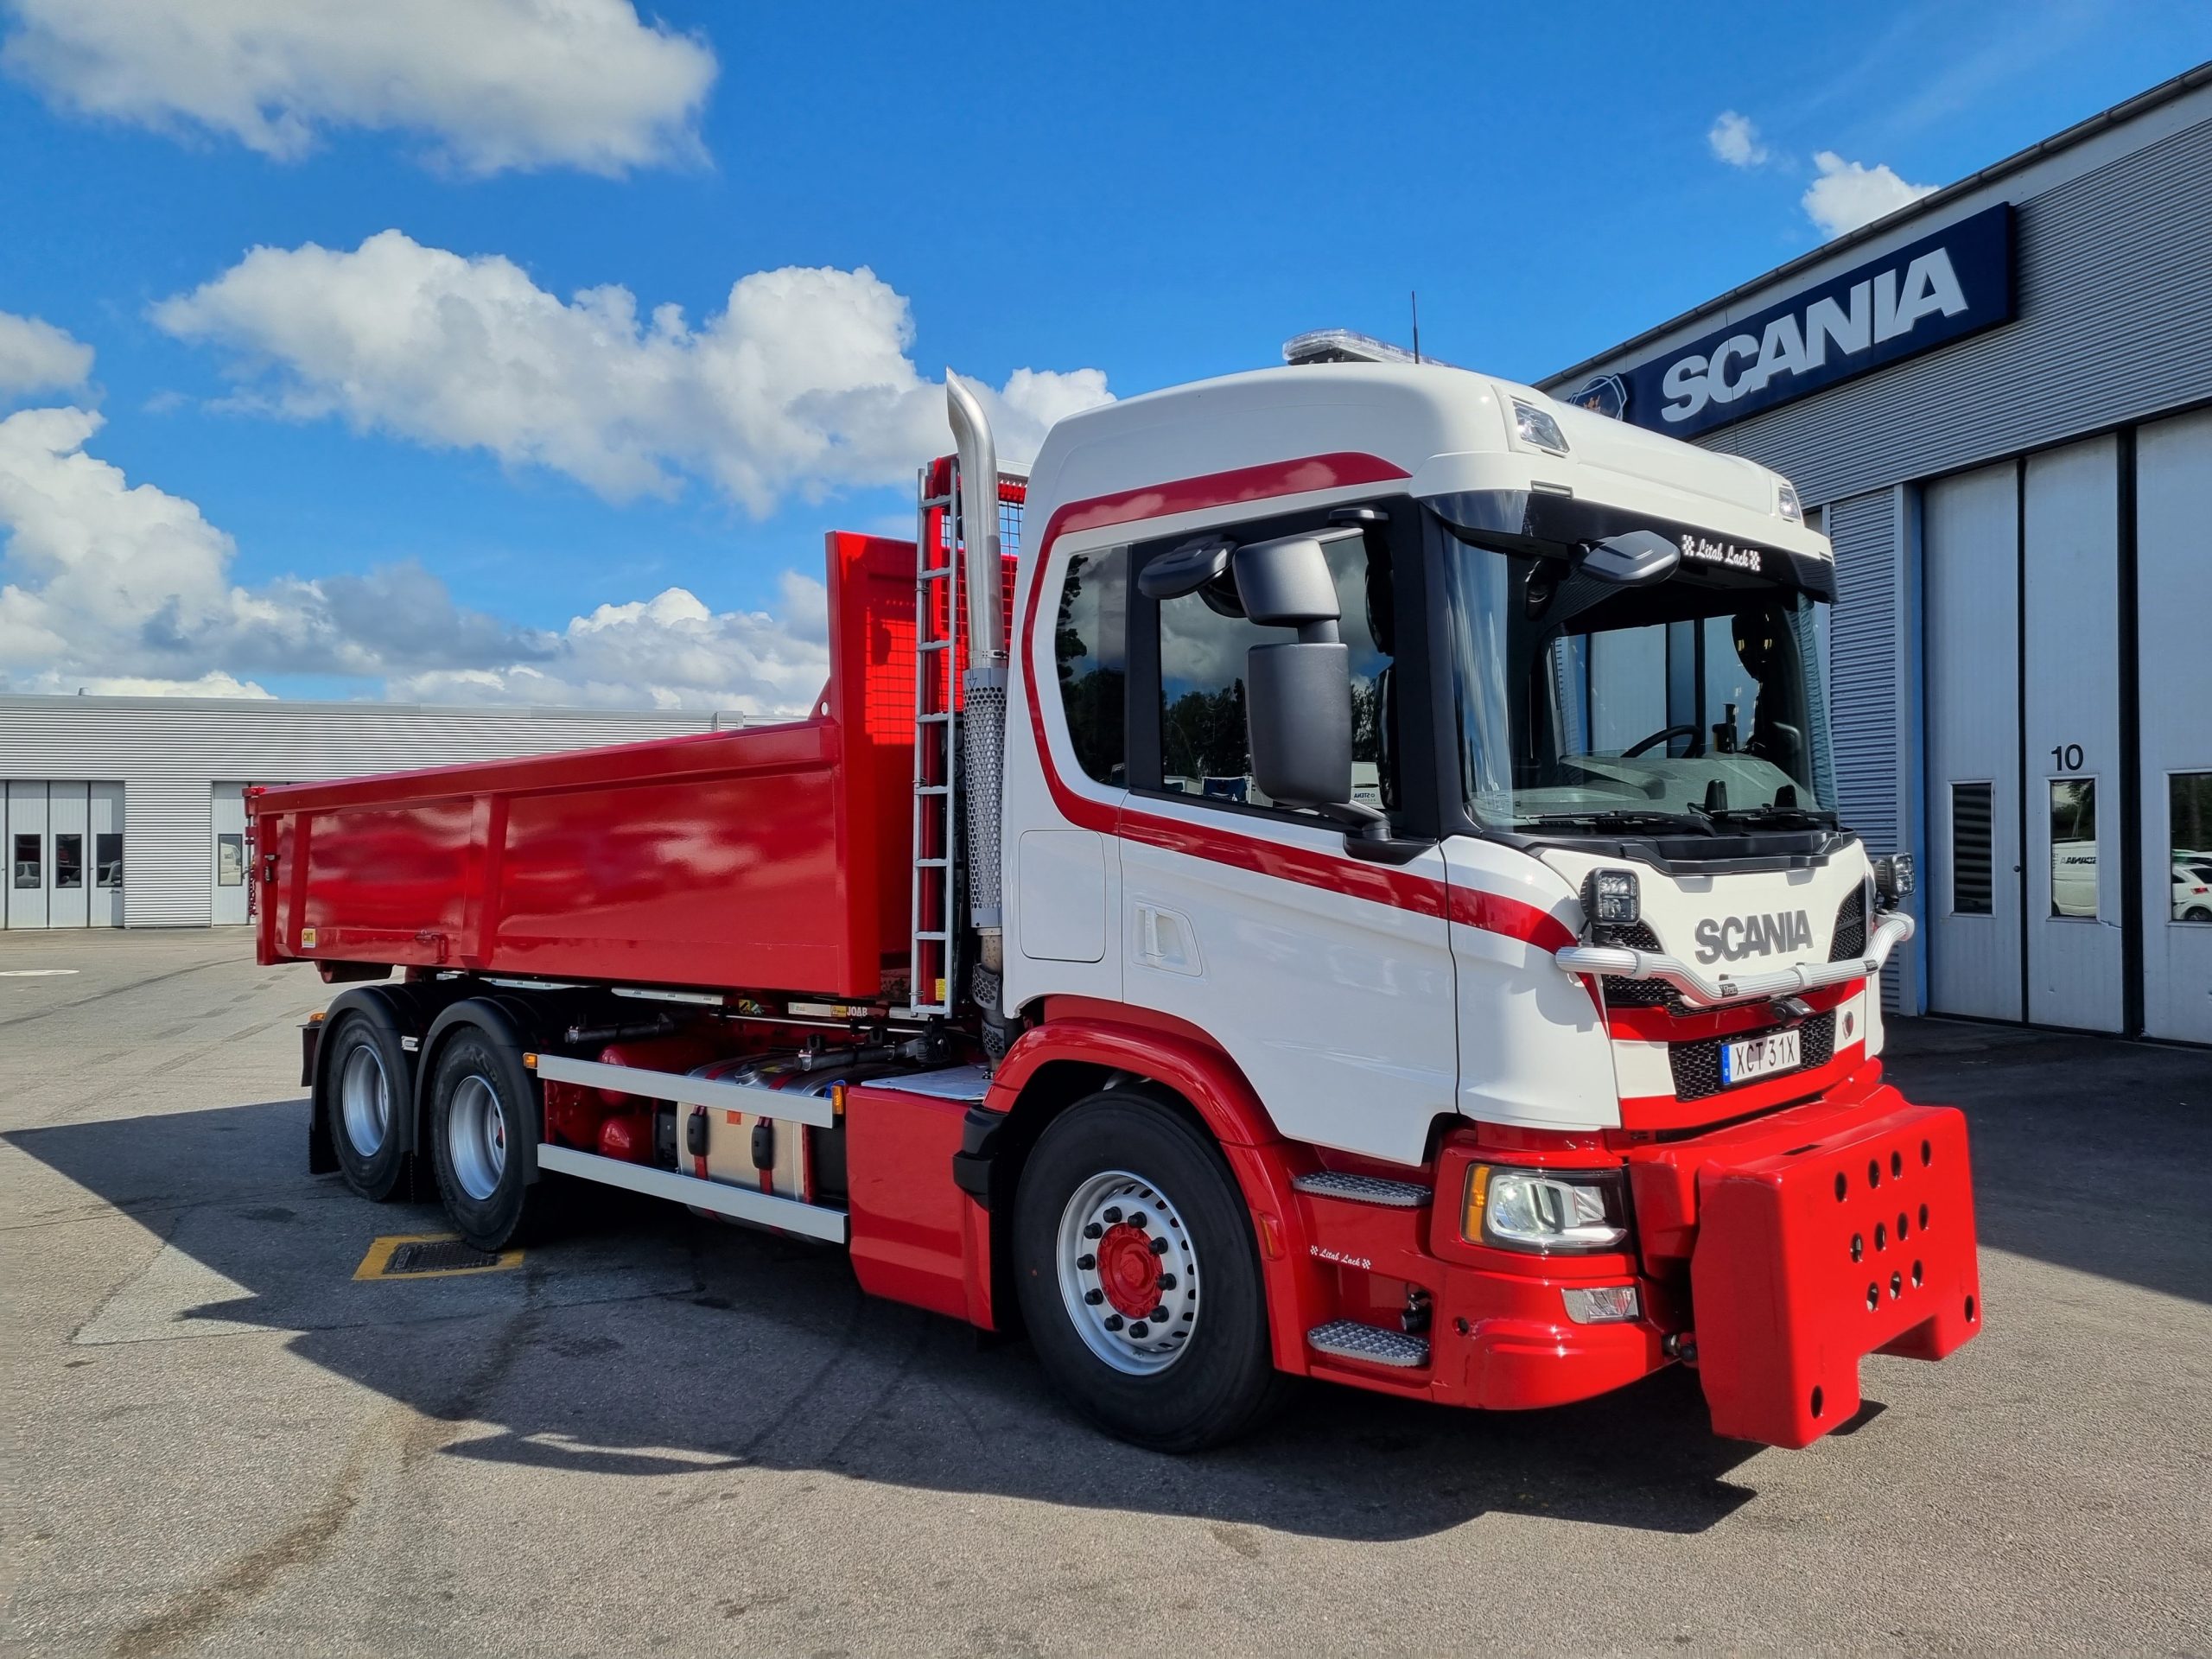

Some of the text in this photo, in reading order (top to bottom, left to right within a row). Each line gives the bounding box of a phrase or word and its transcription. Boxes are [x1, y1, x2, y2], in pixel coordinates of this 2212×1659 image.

[1661, 247, 1969, 423] SCANIA
[1725, 545, 1749, 567] Lack
[2051, 744, 2083, 771] 10
[1694, 910, 1814, 964] SCANIA
[846, 1006, 868, 1017] JOAB
[1736, 1035, 1795, 1076] XCT 31X
[1341, 1255, 1360, 1266] Lack
